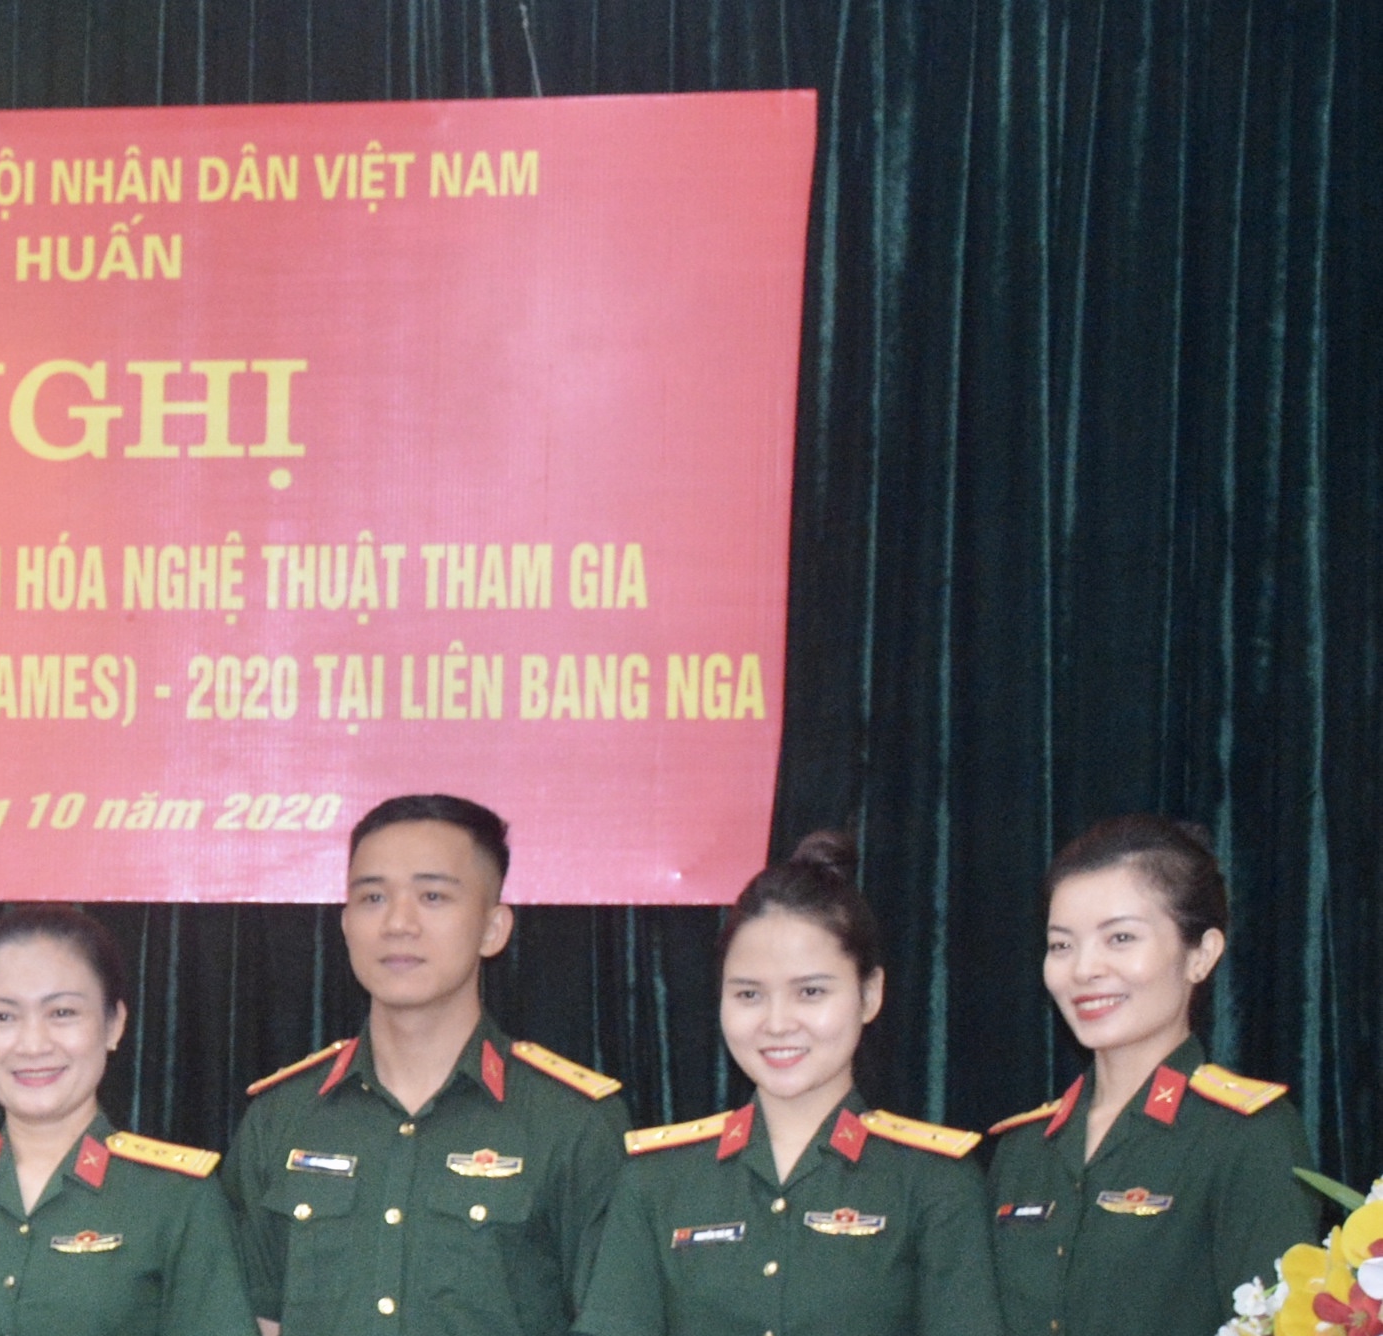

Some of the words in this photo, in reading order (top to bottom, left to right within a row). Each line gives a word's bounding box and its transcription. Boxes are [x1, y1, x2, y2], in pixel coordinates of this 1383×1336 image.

[50, 144, 184, 207] NHÂN
[197, 142, 300, 203] DÂN
[313, 140, 417, 213] VIỆT
[429, 150, 540, 198] NAM
[14, 213, 184, 283] HUẤN
[15, 530, 109, 612] HÓA
[122, 530, 247, 625] NGHỆ
[262, 531, 406, 624] THUẬT
[422, 543, 552, 609] THAM
[570, 543, 649, 609] GIA
[189, 655, 298, 719] 2020
[314, 654, 385, 736] TẠI
[402, 640, 504, 719] LIÊN
[521, 653, 651, 720] BANG
[666, 652, 766, 721] NGA
[27, 791, 86, 830] 10
[92, 791, 205, 830] năm
[213, 792, 344, 832] 2020
